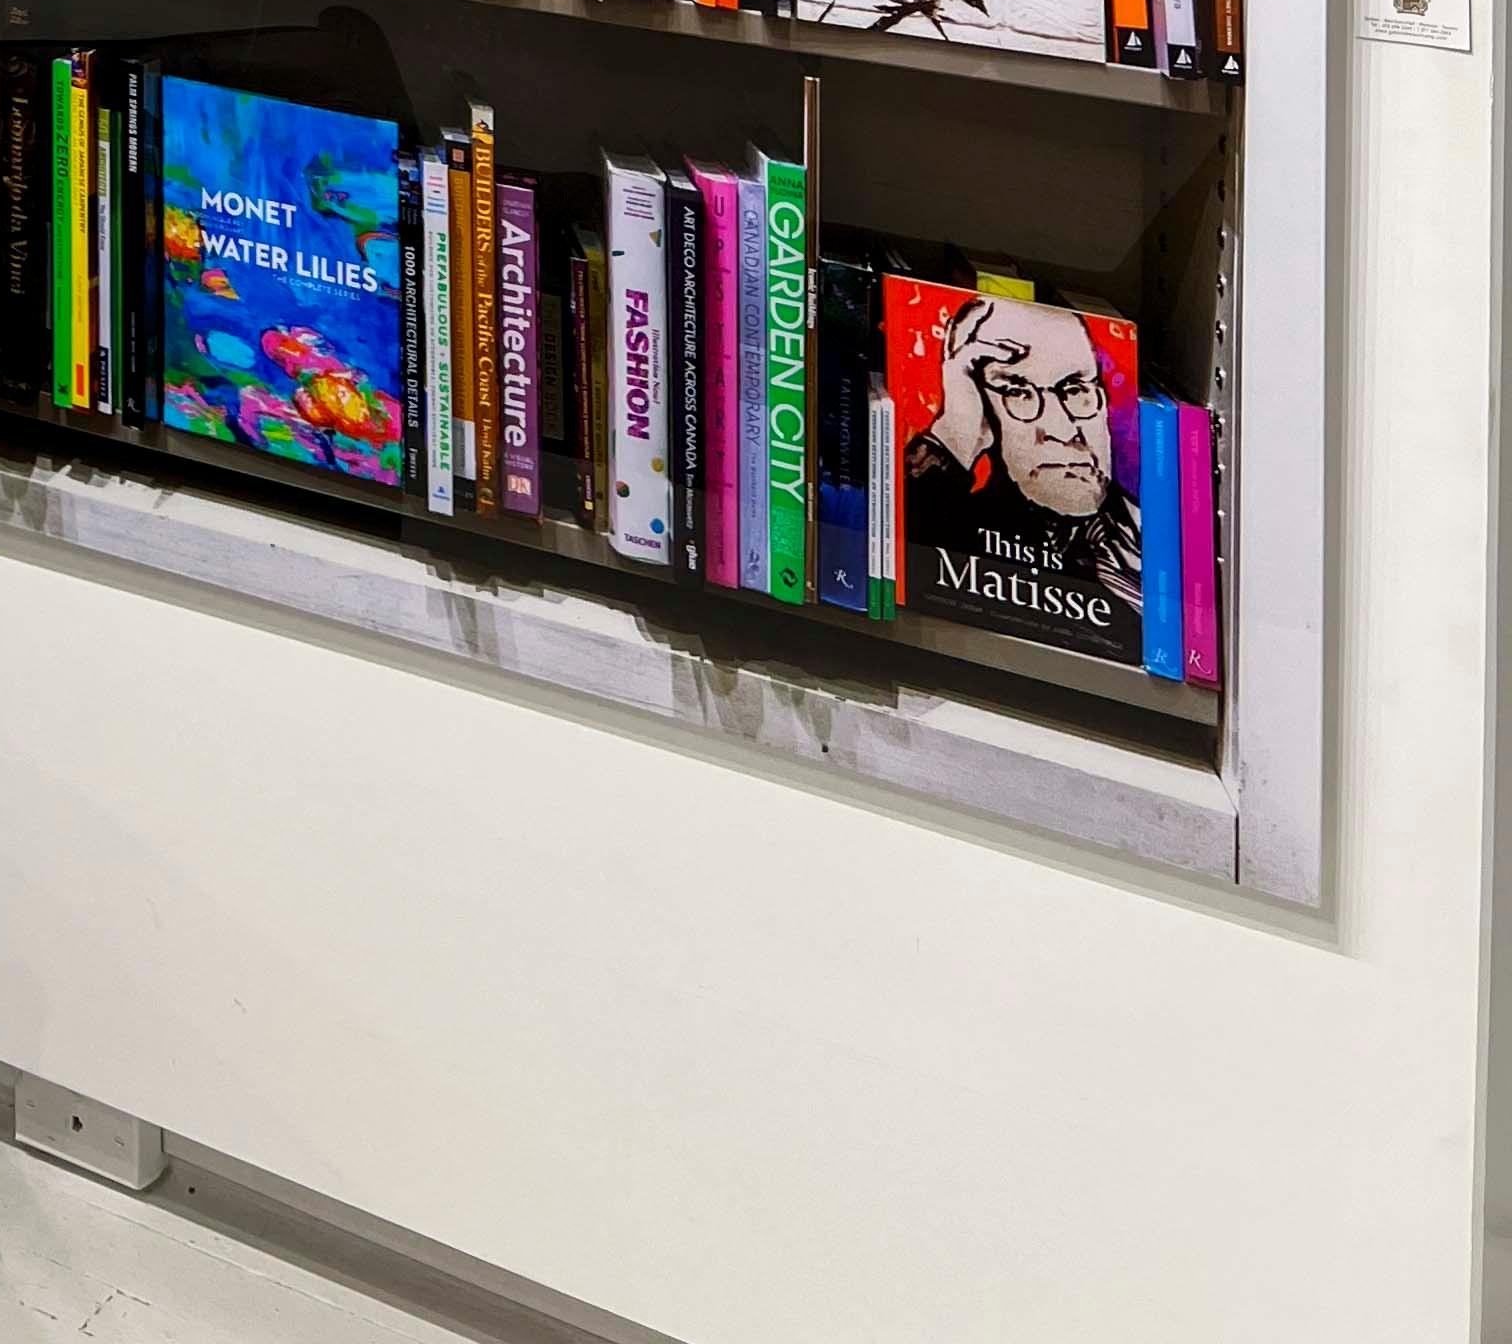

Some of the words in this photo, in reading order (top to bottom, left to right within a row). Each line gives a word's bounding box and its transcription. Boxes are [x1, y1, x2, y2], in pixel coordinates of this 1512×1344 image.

[200, 187, 297, 230] MONET
[683, 207, 696, 231] ART
[200, 230, 289, 273] WATER
[296, 250, 379, 293] LILIES
[683, 232, 696, 268] DECO
[684, 270, 697, 359] ARCHITECTURE
[768, 201, 805, 390] GARDEN
[499, 219, 533, 449] Architecture
[625, 288, 650, 441] FASHION
[684, 361, 697, 412] ACROSS
[685, 414, 698, 471] CANADA
[770, 403, 805, 505] CITY
[978, 527, 1036, 564] This
[1042, 542, 1064, 571] is
[935, 547, 1112, 627] Matisse
